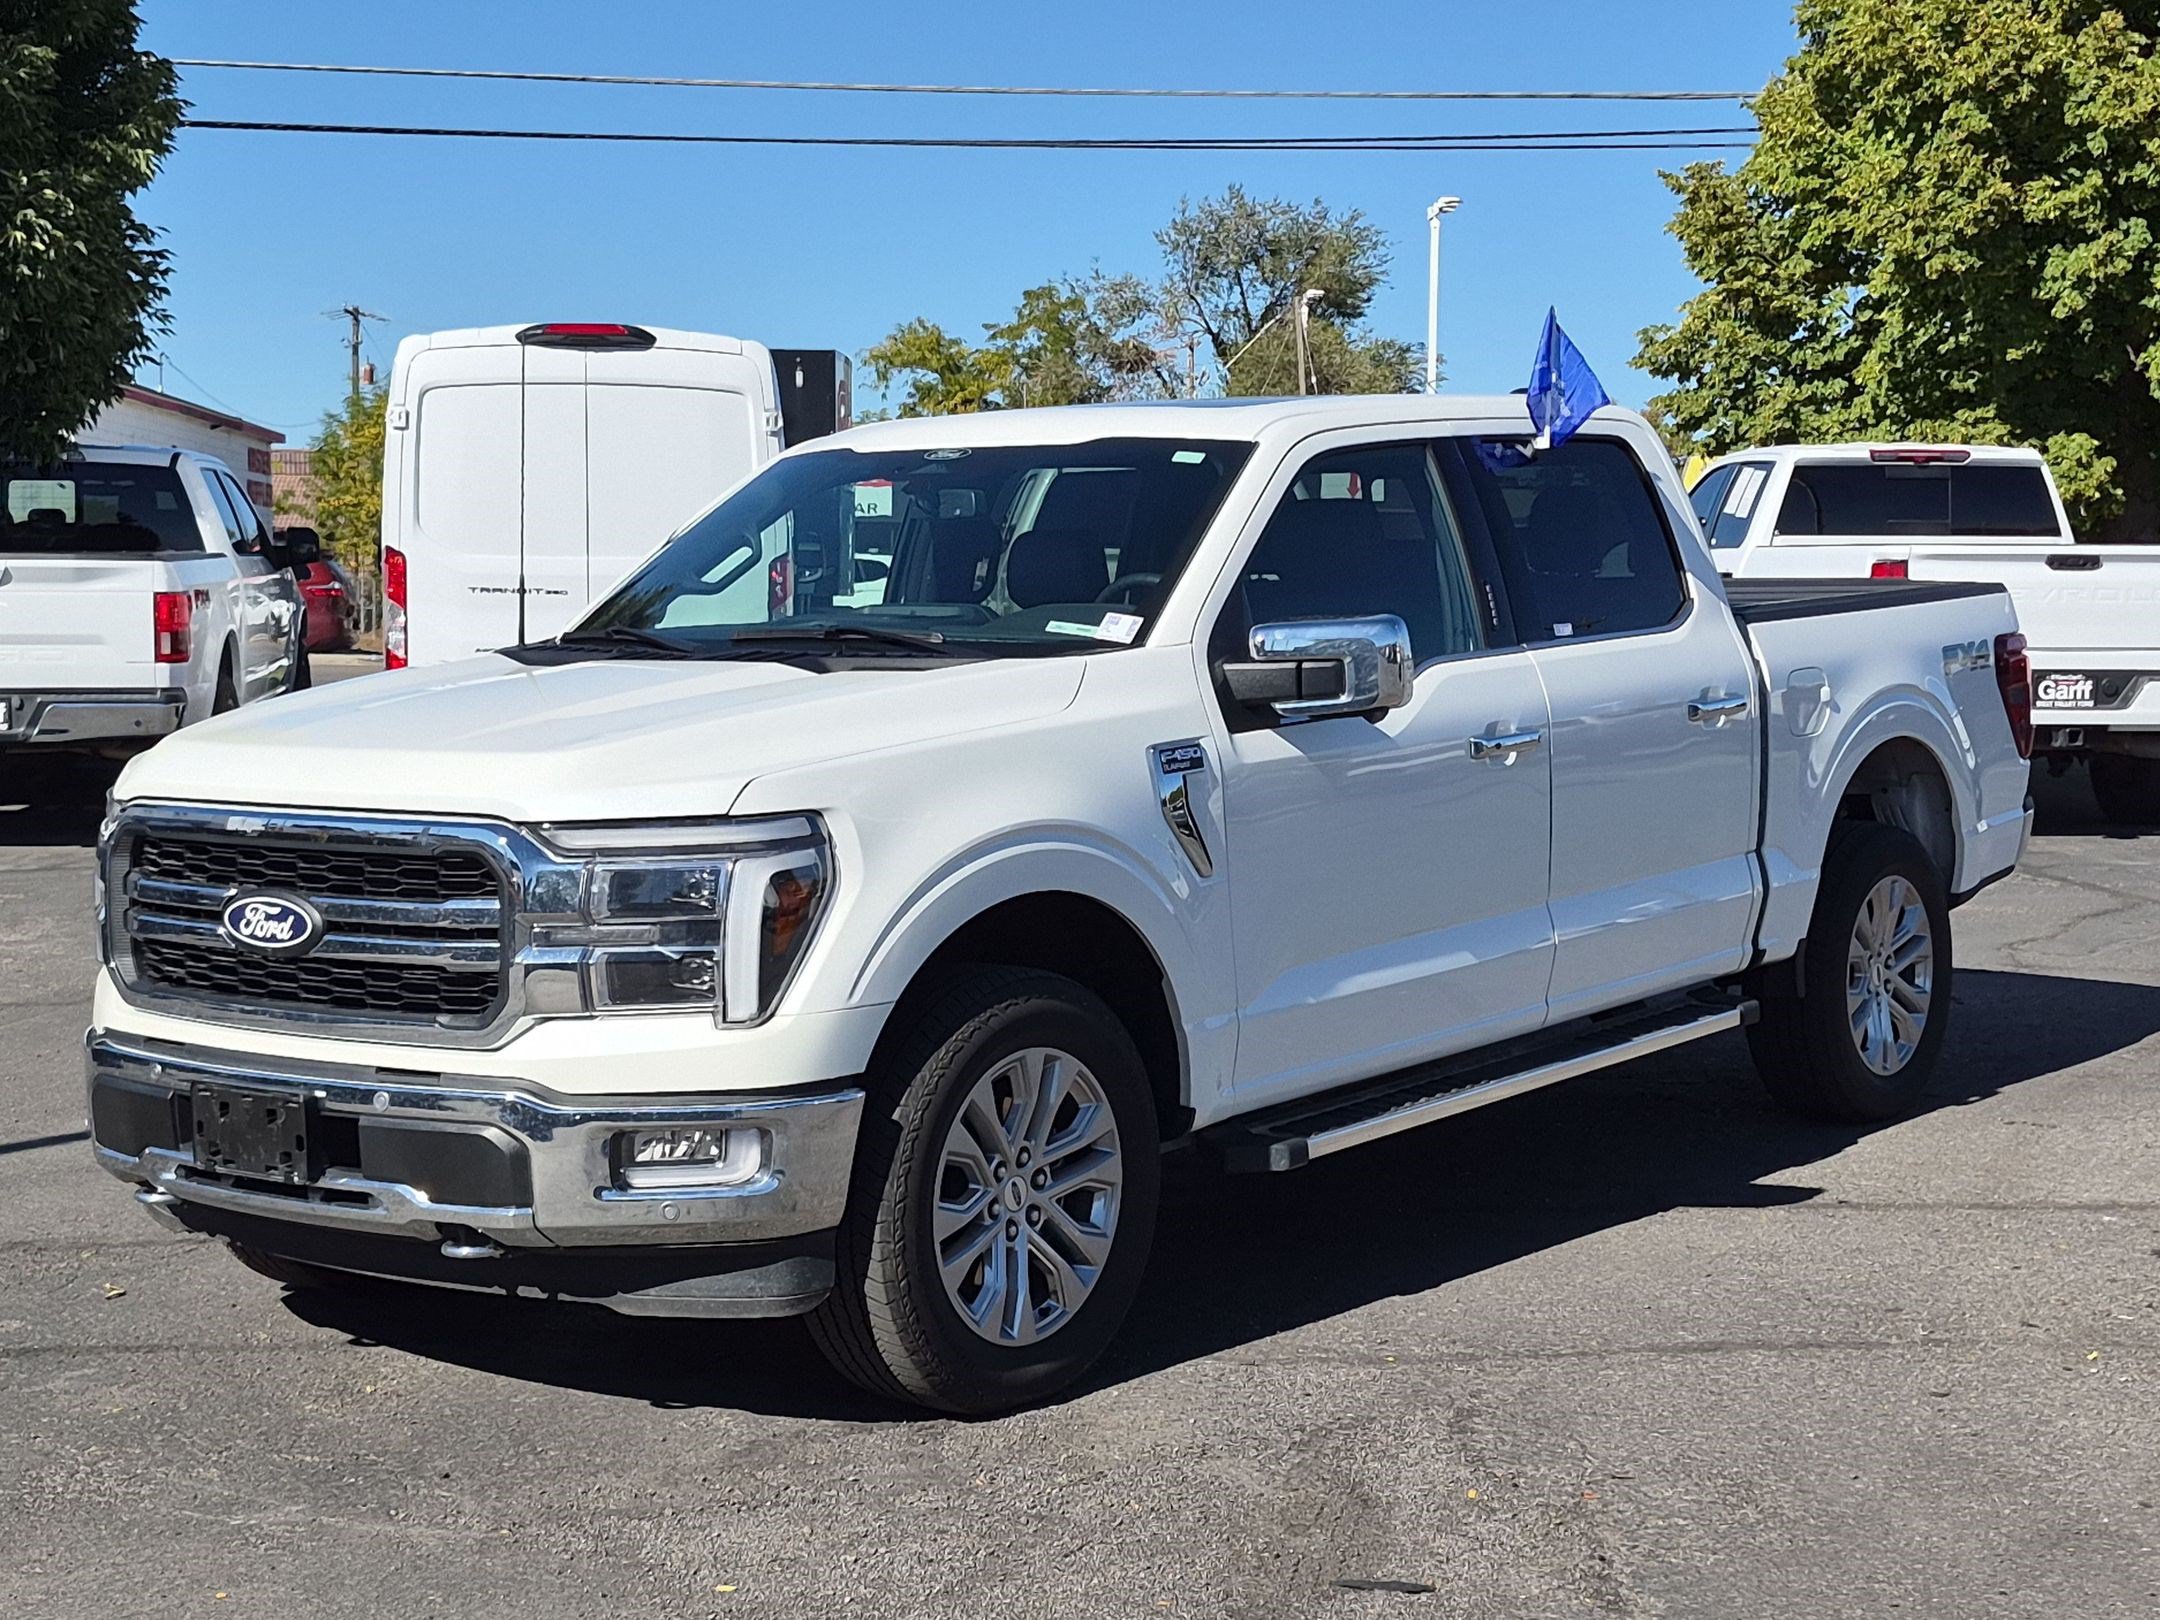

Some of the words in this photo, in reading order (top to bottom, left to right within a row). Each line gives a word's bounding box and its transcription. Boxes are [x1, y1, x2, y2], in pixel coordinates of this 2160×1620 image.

[1942, 639, 1991, 676] FX4
[2037, 680, 2093, 700] Garff
[240, 903, 294, 940] Ford
